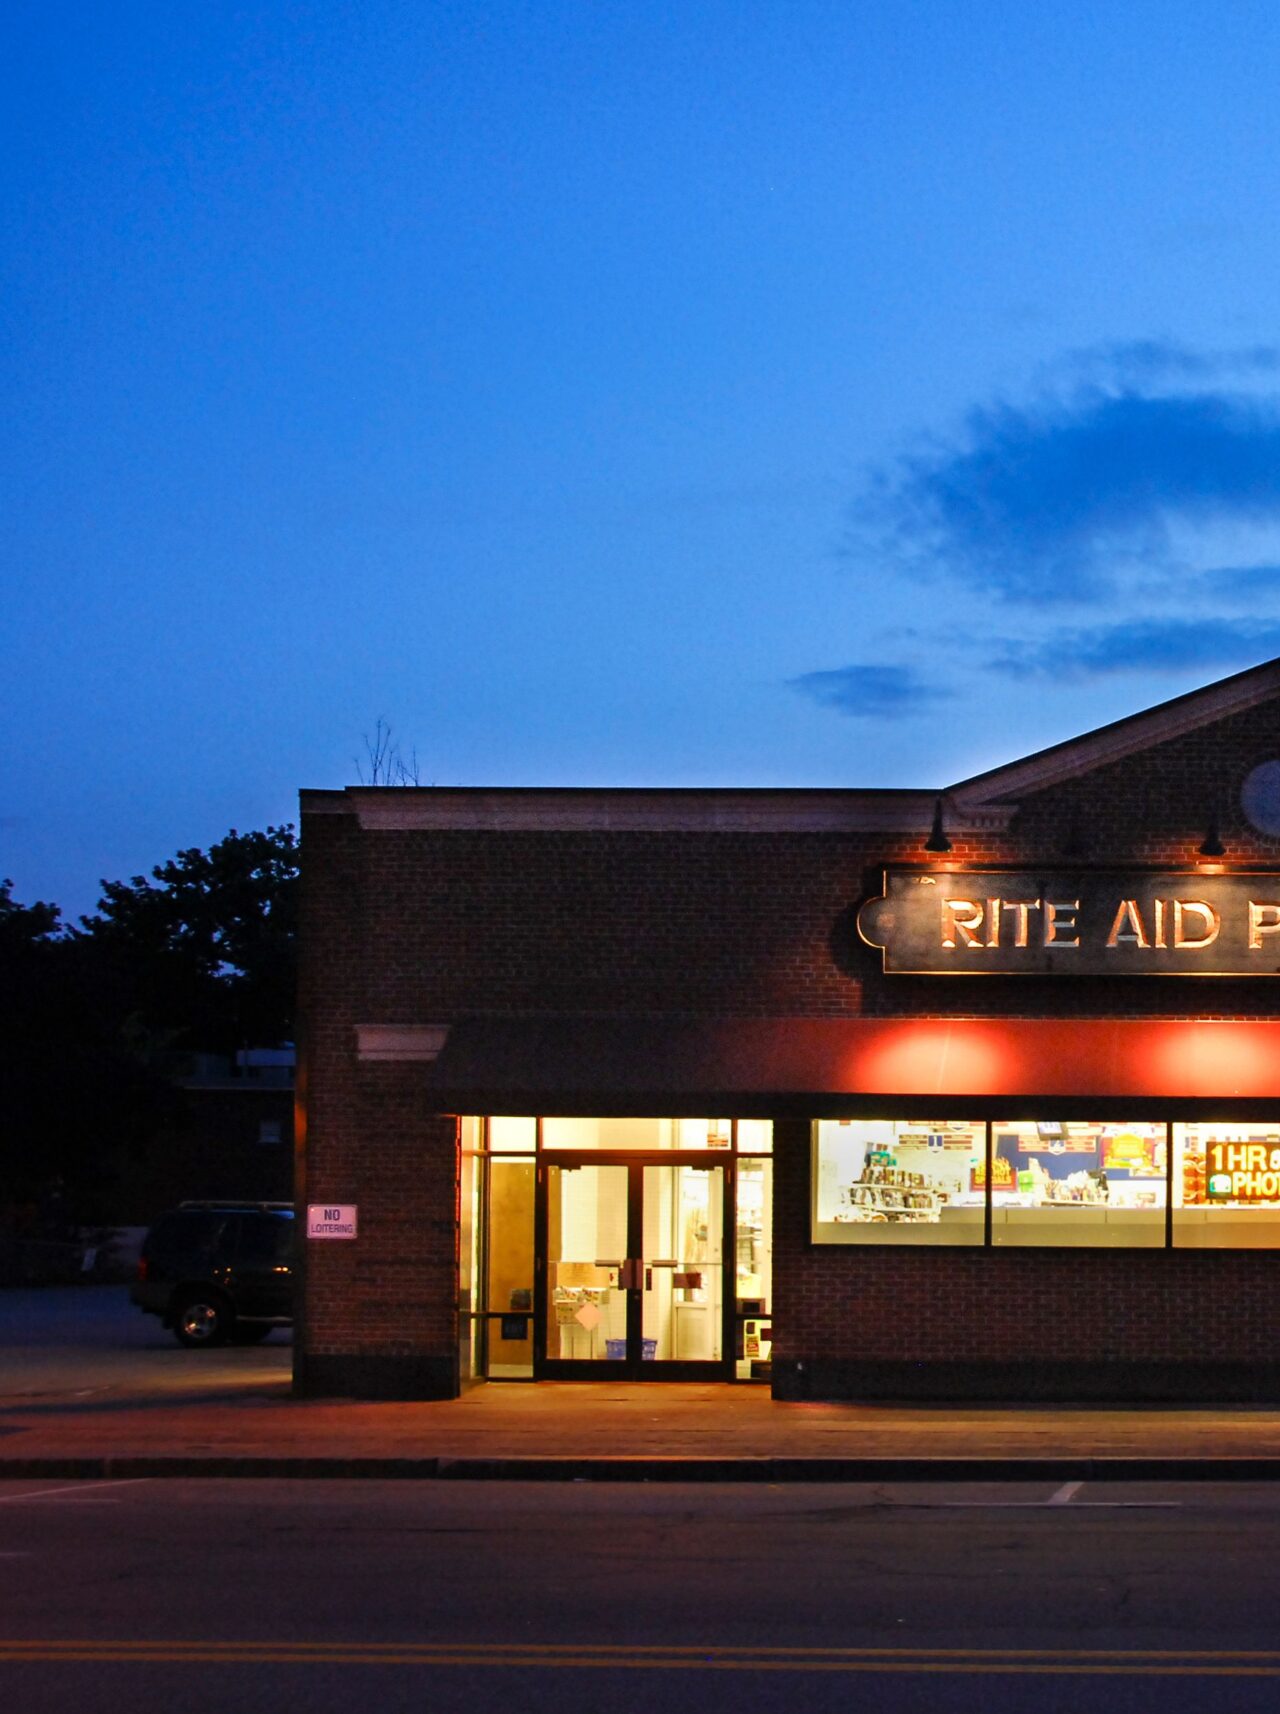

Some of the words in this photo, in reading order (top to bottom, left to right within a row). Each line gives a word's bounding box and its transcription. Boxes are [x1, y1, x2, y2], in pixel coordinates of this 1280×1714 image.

[941, 898, 1080, 948] RITE
[1105, 898, 1221, 949] AID
[1211, 1145, 1222, 1171] 1
[1228, 1145, 1268, 1171] HR
[324, 1209, 340, 1221] NO
[311, 1224, 353, 1233] LOITERING
